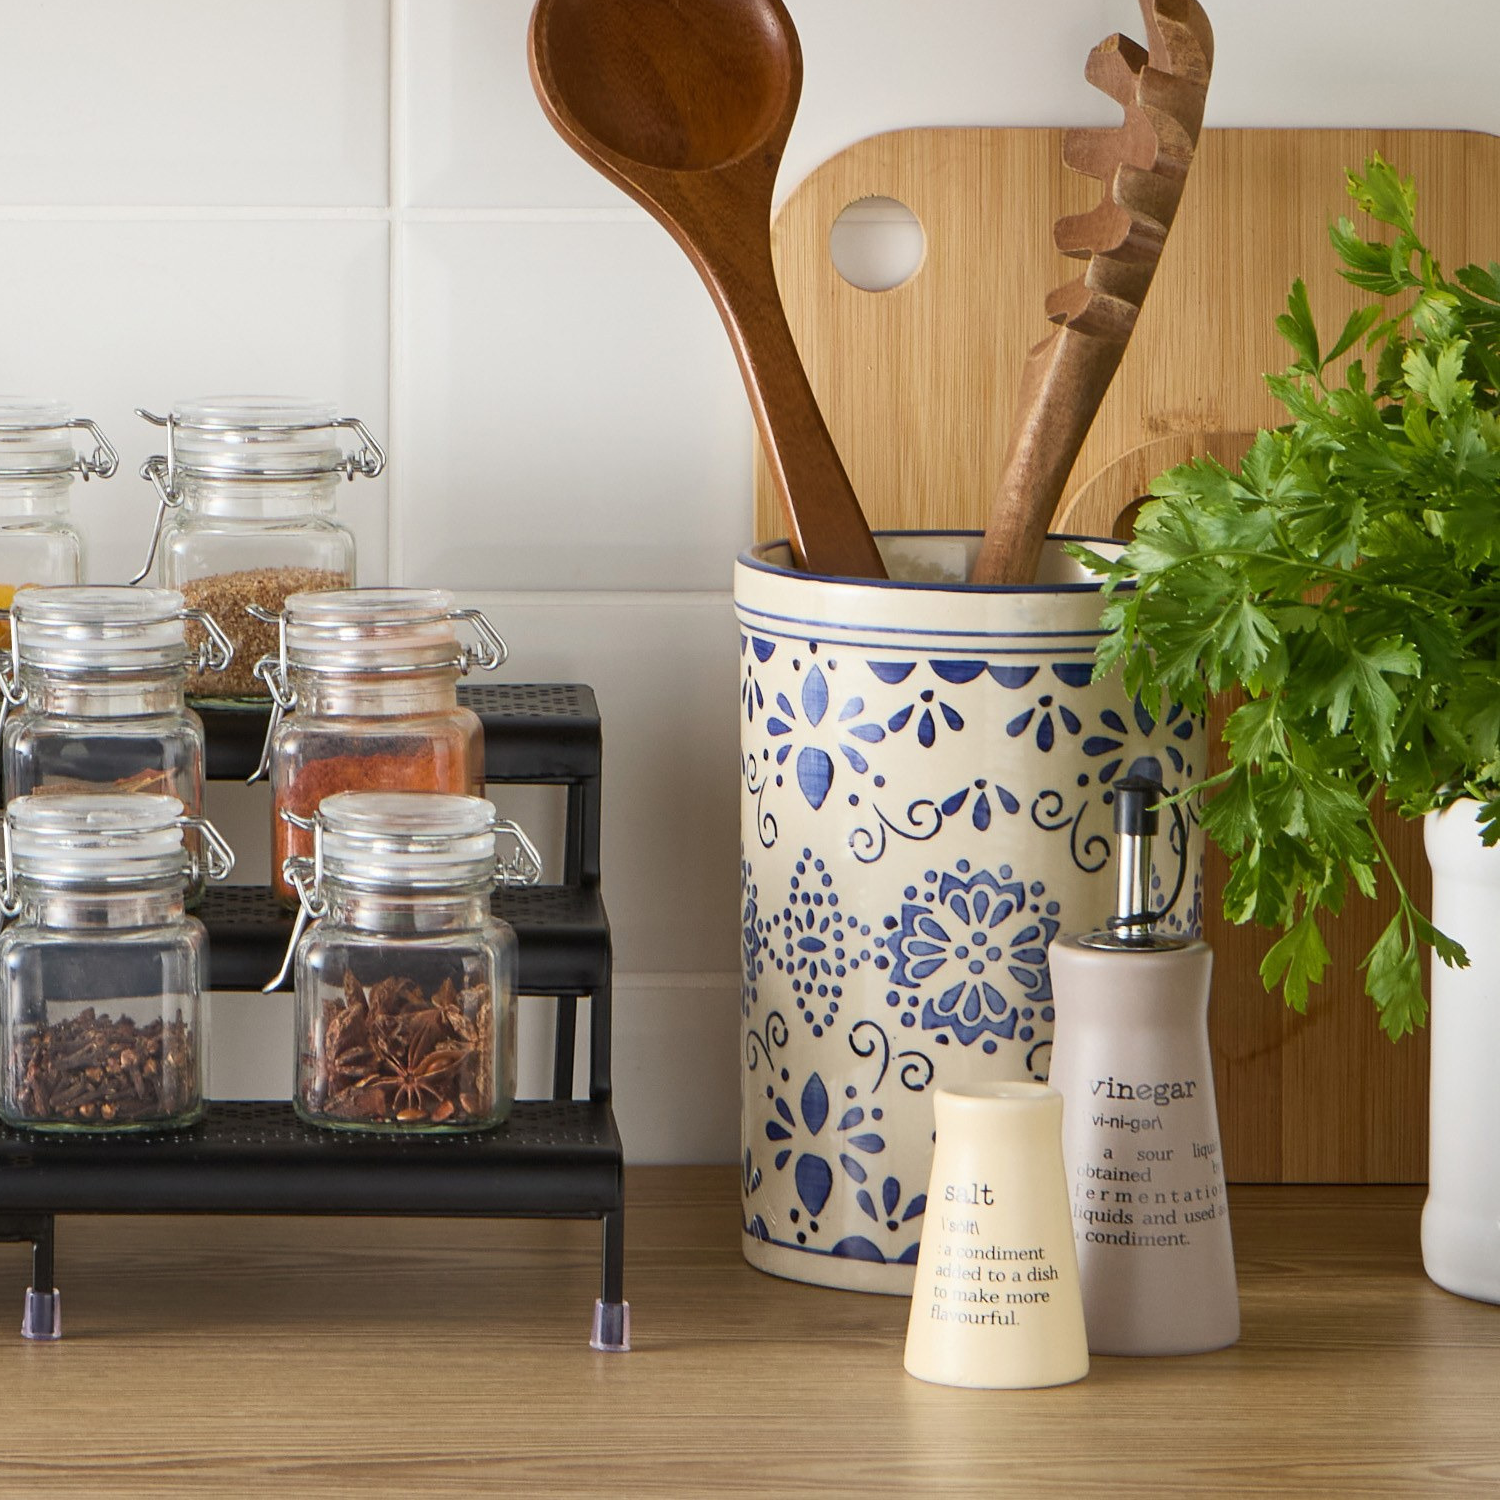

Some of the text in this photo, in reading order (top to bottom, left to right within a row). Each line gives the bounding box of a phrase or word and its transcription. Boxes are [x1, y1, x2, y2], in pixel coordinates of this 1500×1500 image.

[1090, 1077, 1197, 1106] vinegar
[1103, 1148, 1113, 1159] a
[1137, 1149, 1173, 1162] sour
[1077, 1163, 1152, 1182] obtained
[945, 1183, 994, 1205] salt
[1073, 1204, 1133, 1225] liquids
[1142, 1209, 1177, 1225] and
[1184, 1204, 1215, 1224] used
[1085, 1230, 1190, 1246] condiment.
[956, 1246, 1045, 1260] condiment
[935, 1263, 1059, 1282] added to a dish
[934, 1286, 1050, 1303] to make more
[931, 1304, 1020, 1325] flavourful.
